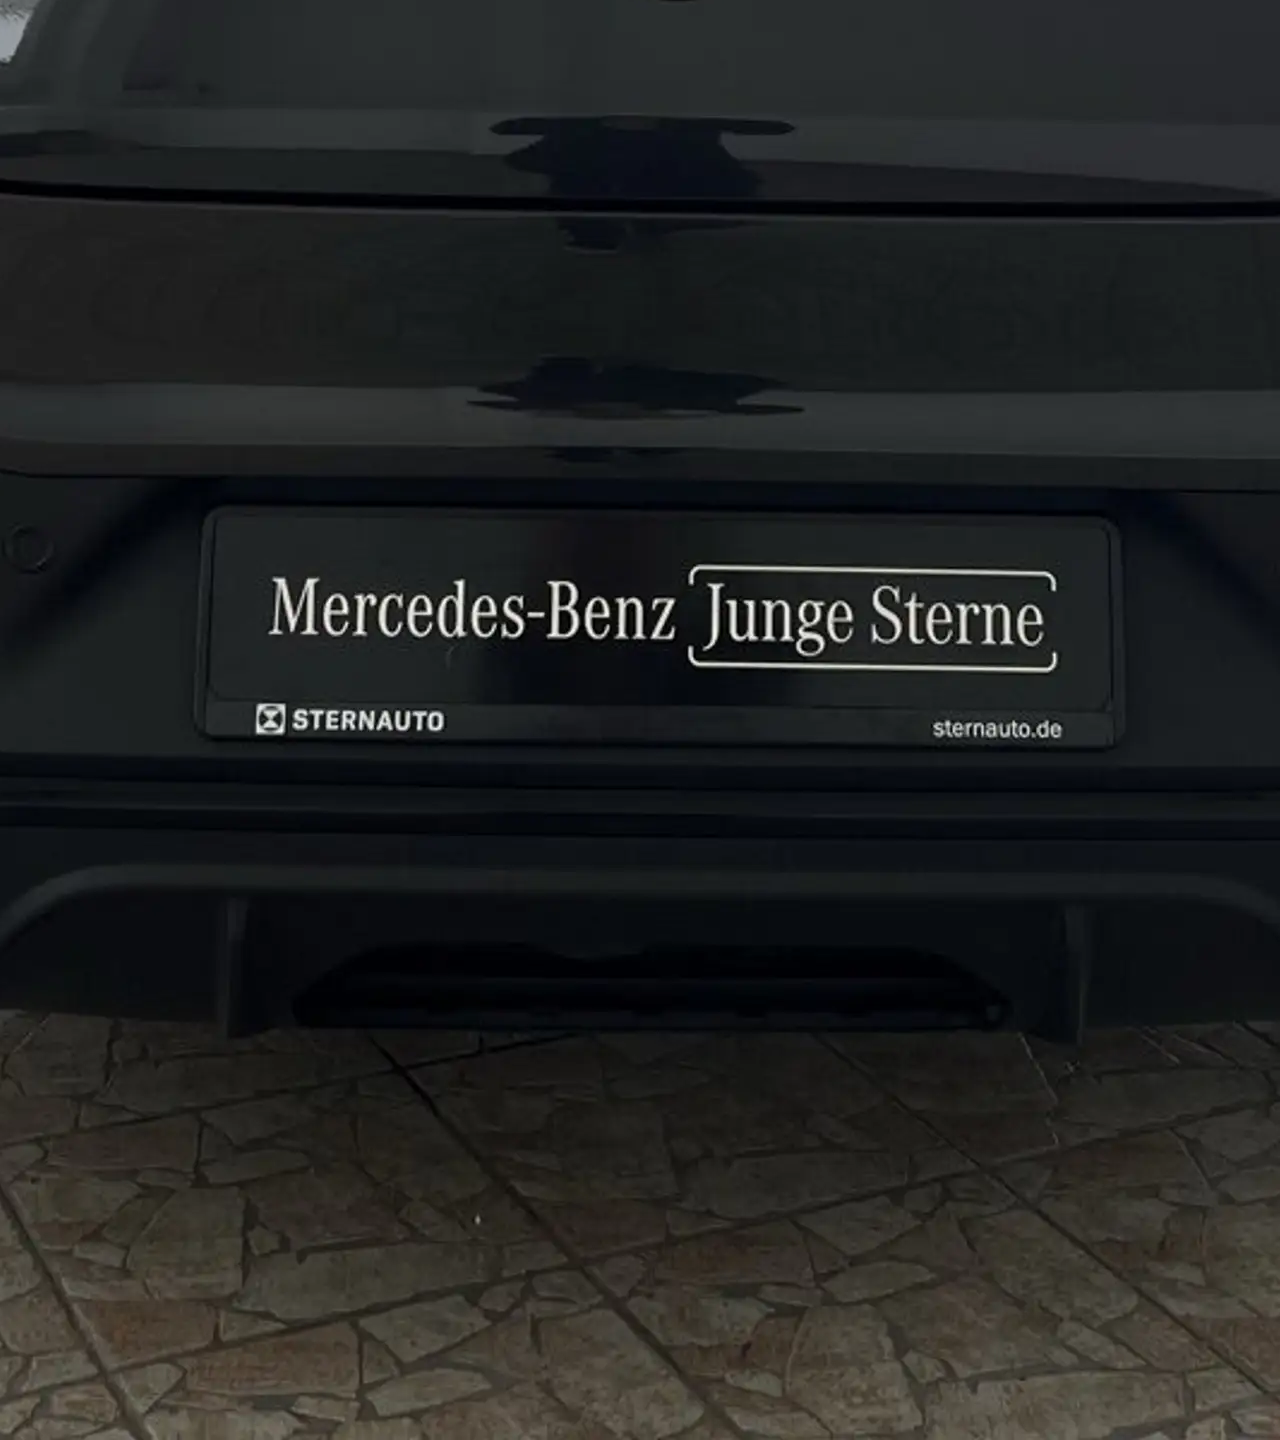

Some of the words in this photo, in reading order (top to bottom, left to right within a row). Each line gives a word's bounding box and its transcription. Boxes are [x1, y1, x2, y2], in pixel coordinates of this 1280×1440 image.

[267, 576, 677, 642] Mercedes-Benz
[702, 582, 855, 657] Junge
[870, 584, 1045, 647] Sterne
[291, 708, 446, 733] STERNAUTO
[932, 719, 1063, 740] sternauto.de
